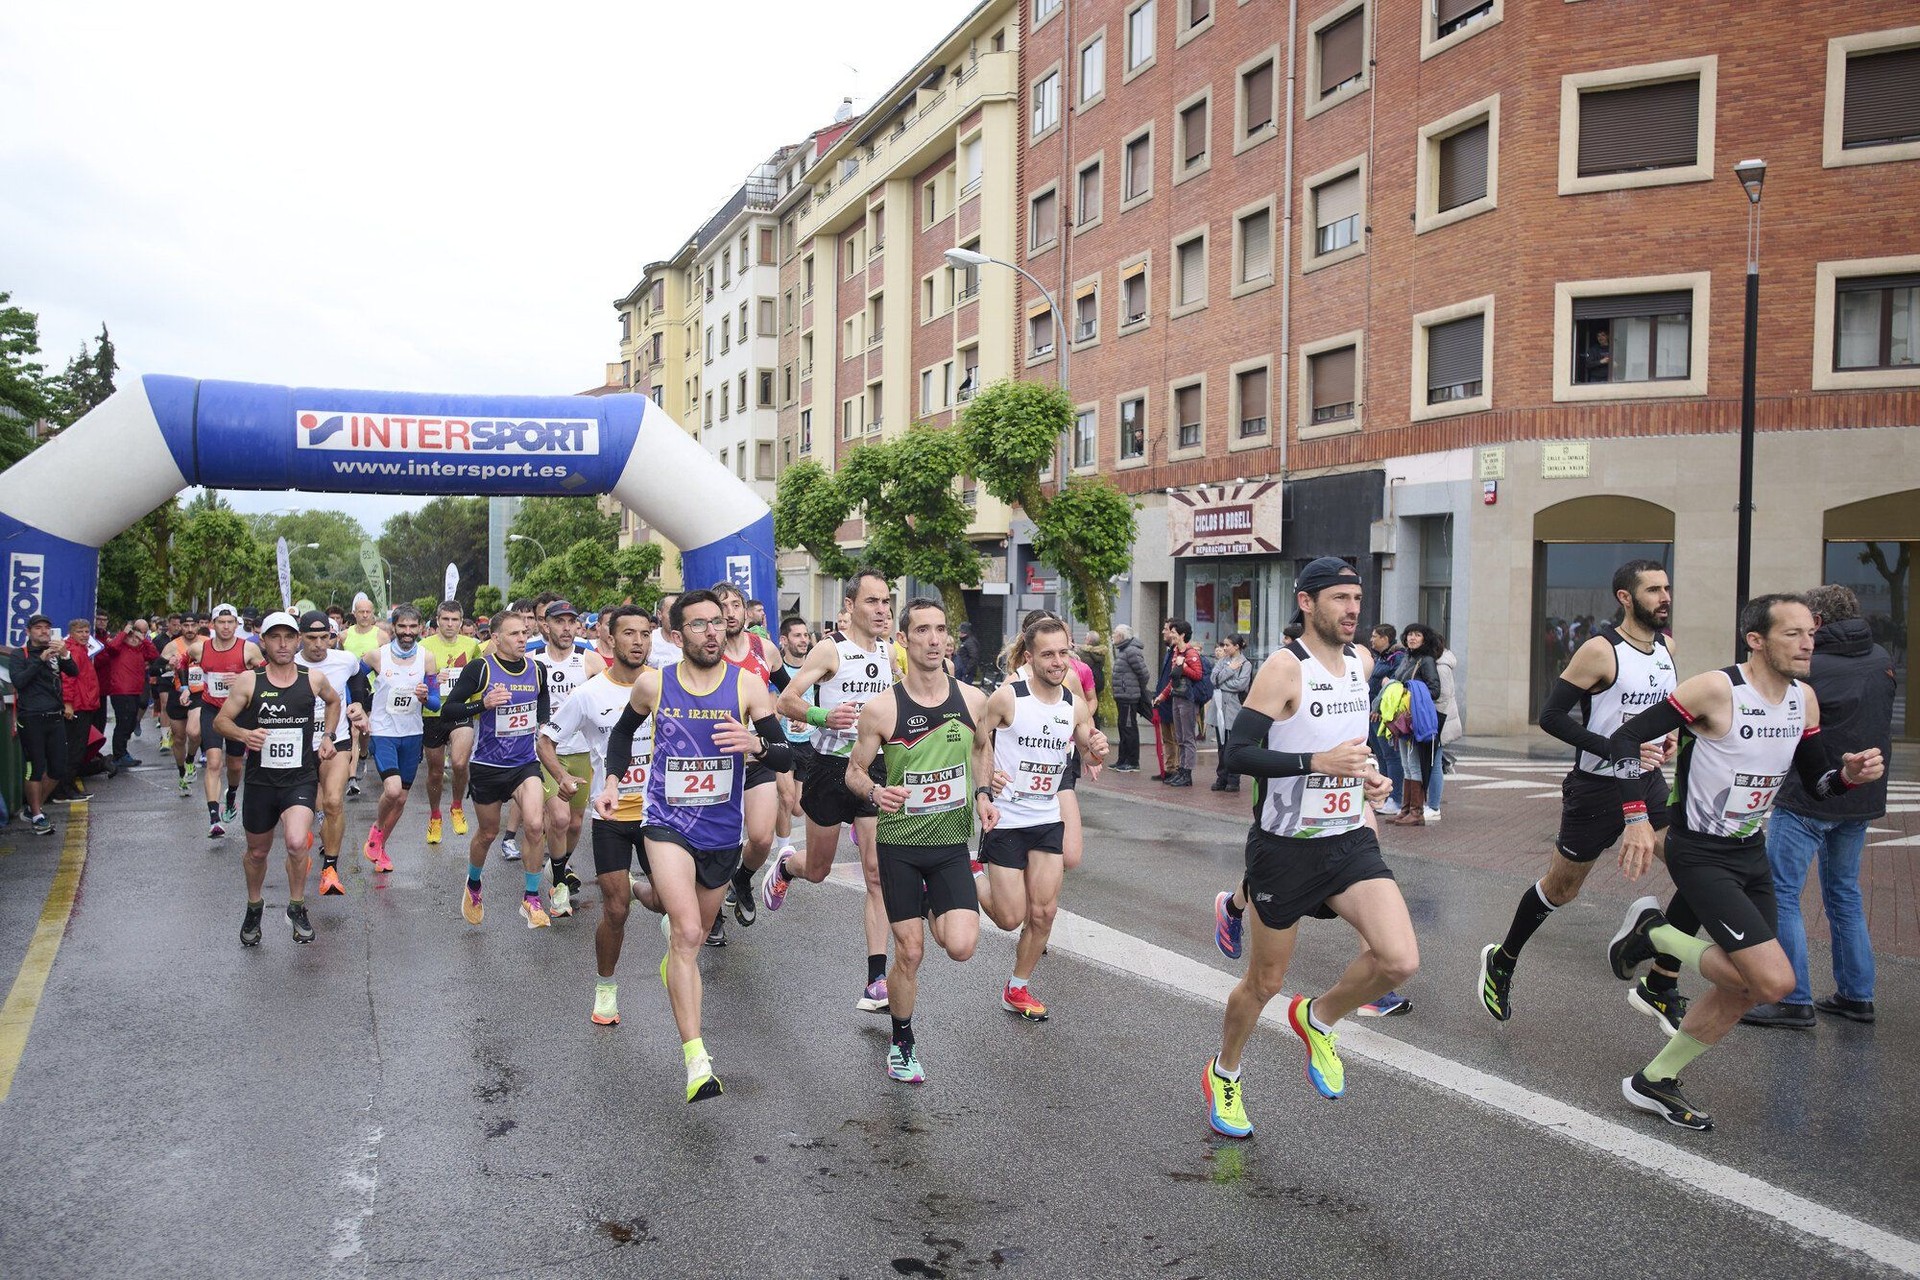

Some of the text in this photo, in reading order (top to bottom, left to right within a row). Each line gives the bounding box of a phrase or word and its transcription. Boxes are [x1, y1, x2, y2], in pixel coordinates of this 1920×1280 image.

[351, 416, 588, 452] INTERSPORT
[333, 459, 567, 480] www.intersport.es
[1195, 513, 1218, 532] CICLOS
[1225, 511, 1251, 530] ROSELL
[394, 696, 412, 707] 657
[509, 715, 528, 728] 25
[911, 717, 925, 725] KIA
[270, 743, 294, 758] 663
[682, 760, 718, 771] A4XKM
[684, 774, 715, 793] 24
[920, 769, 953, 784] A4XKM
[1030, 776, 1052, 791] 35
[1323, 776, 1355, 788] A4XKM
[923, 784, 951, 803] 29
[1747, 790, 1773, 809] 31
[1323, 792, 1351, 814] 36
